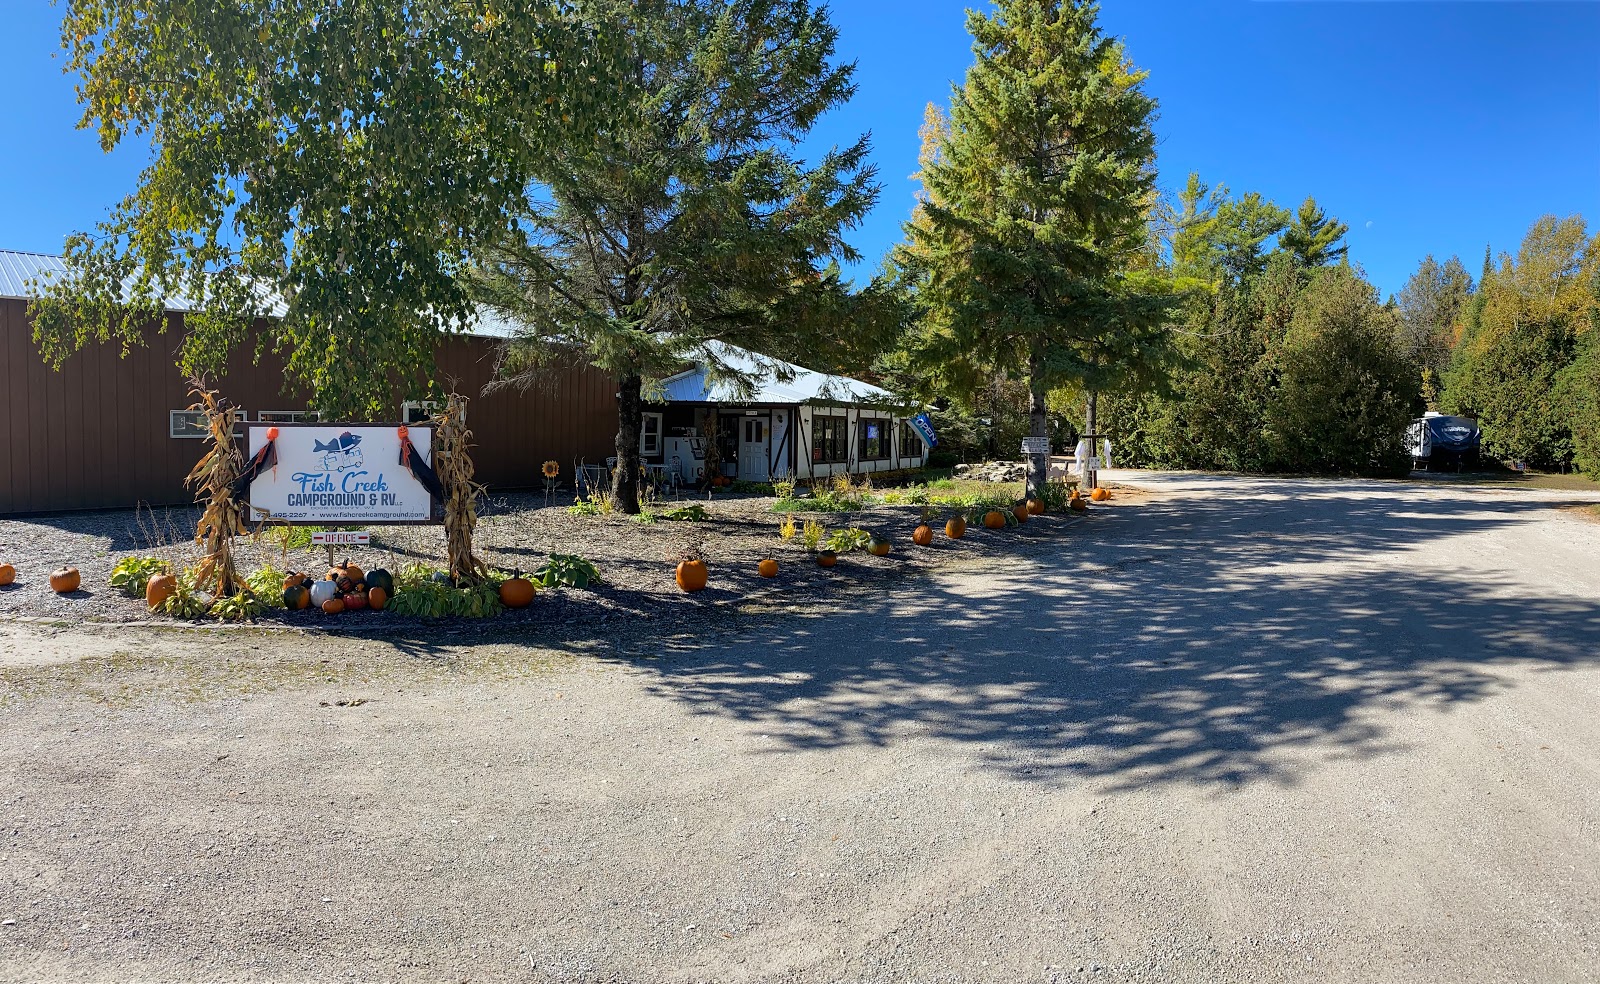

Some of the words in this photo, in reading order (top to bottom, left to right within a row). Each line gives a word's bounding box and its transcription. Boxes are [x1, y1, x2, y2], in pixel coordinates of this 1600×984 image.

[915, 418, 937, 442] OPEN
[291, 472, 336, 493] Fish
[341, 470, 389, 493] Creek
[287, 493, 365, 506] CAMPGROUND
[369, 493, 378, 506] &
[381, 493, 396, 506] RV
[325, 533, 356, 543] OFFICE
